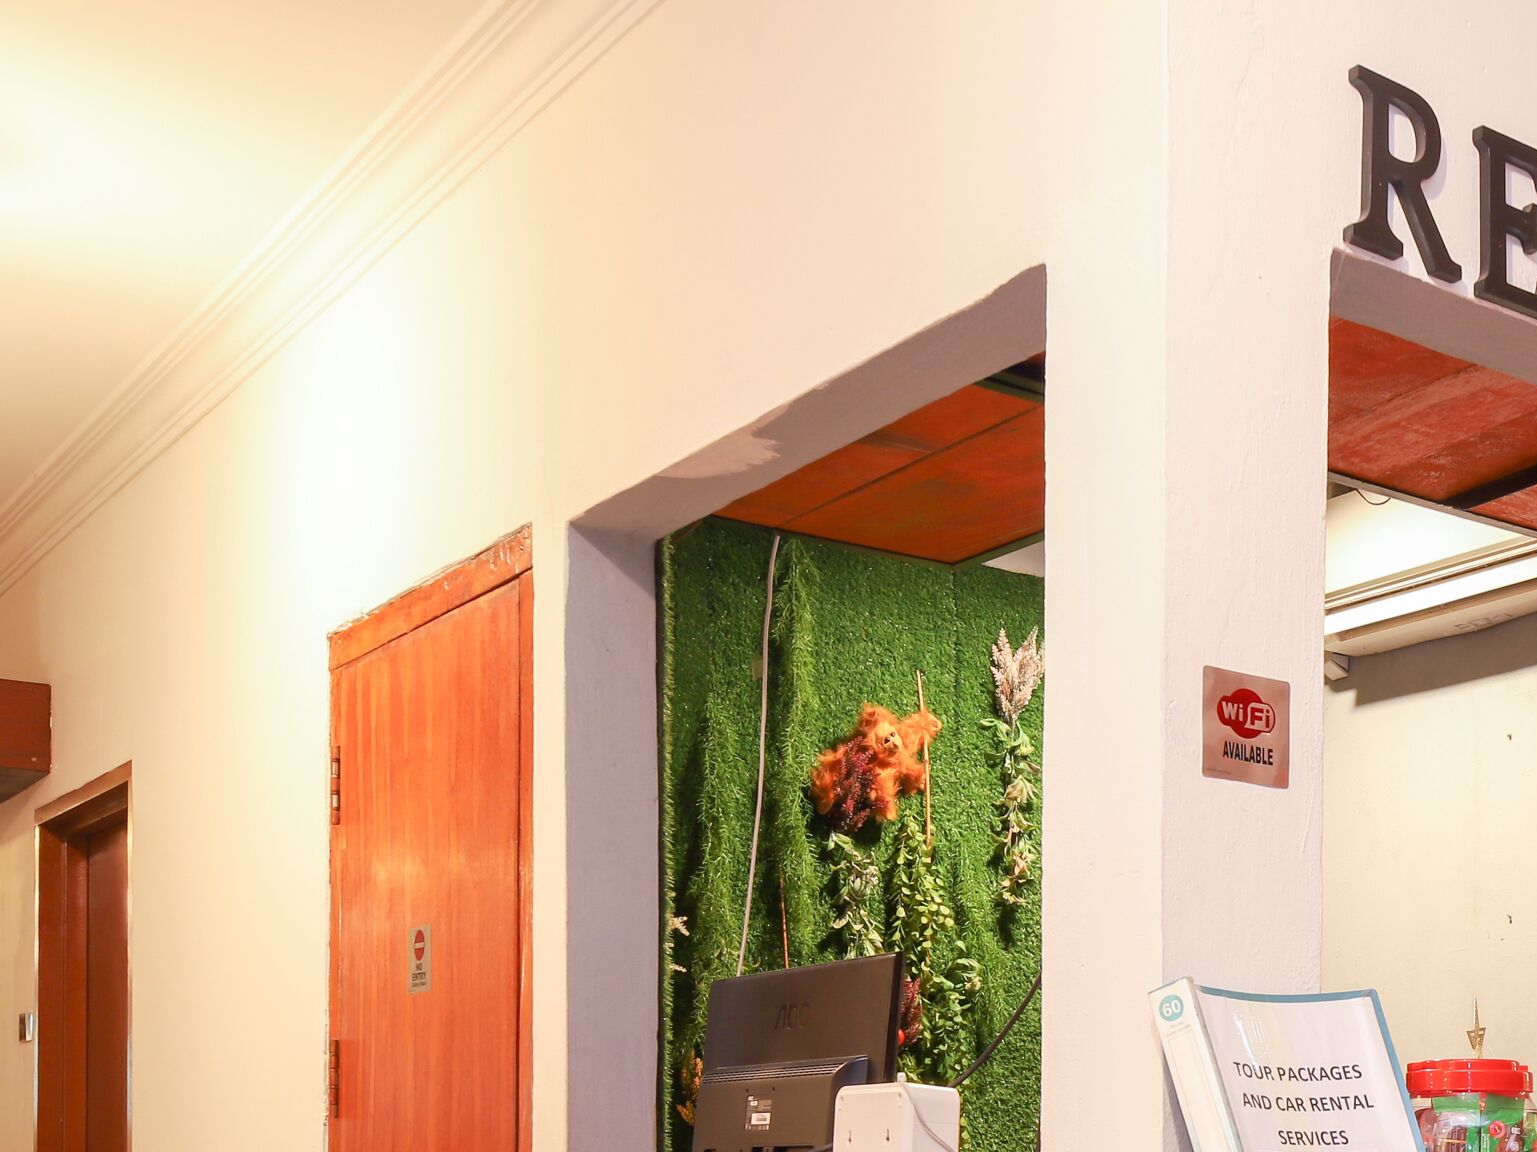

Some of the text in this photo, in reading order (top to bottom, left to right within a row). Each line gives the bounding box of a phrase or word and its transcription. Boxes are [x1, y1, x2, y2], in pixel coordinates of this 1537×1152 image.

[1222, 741, 1274, 766] AVAILABLE
[1162, 999, 1181, 1017] 60
[1232, 1061, 1363, 1082] TOUR PACKAGES
[1242, 1092, 1375, 1112] AND CAR RENTAL
[1278, 1130, 1349, 1146] SERVICES
